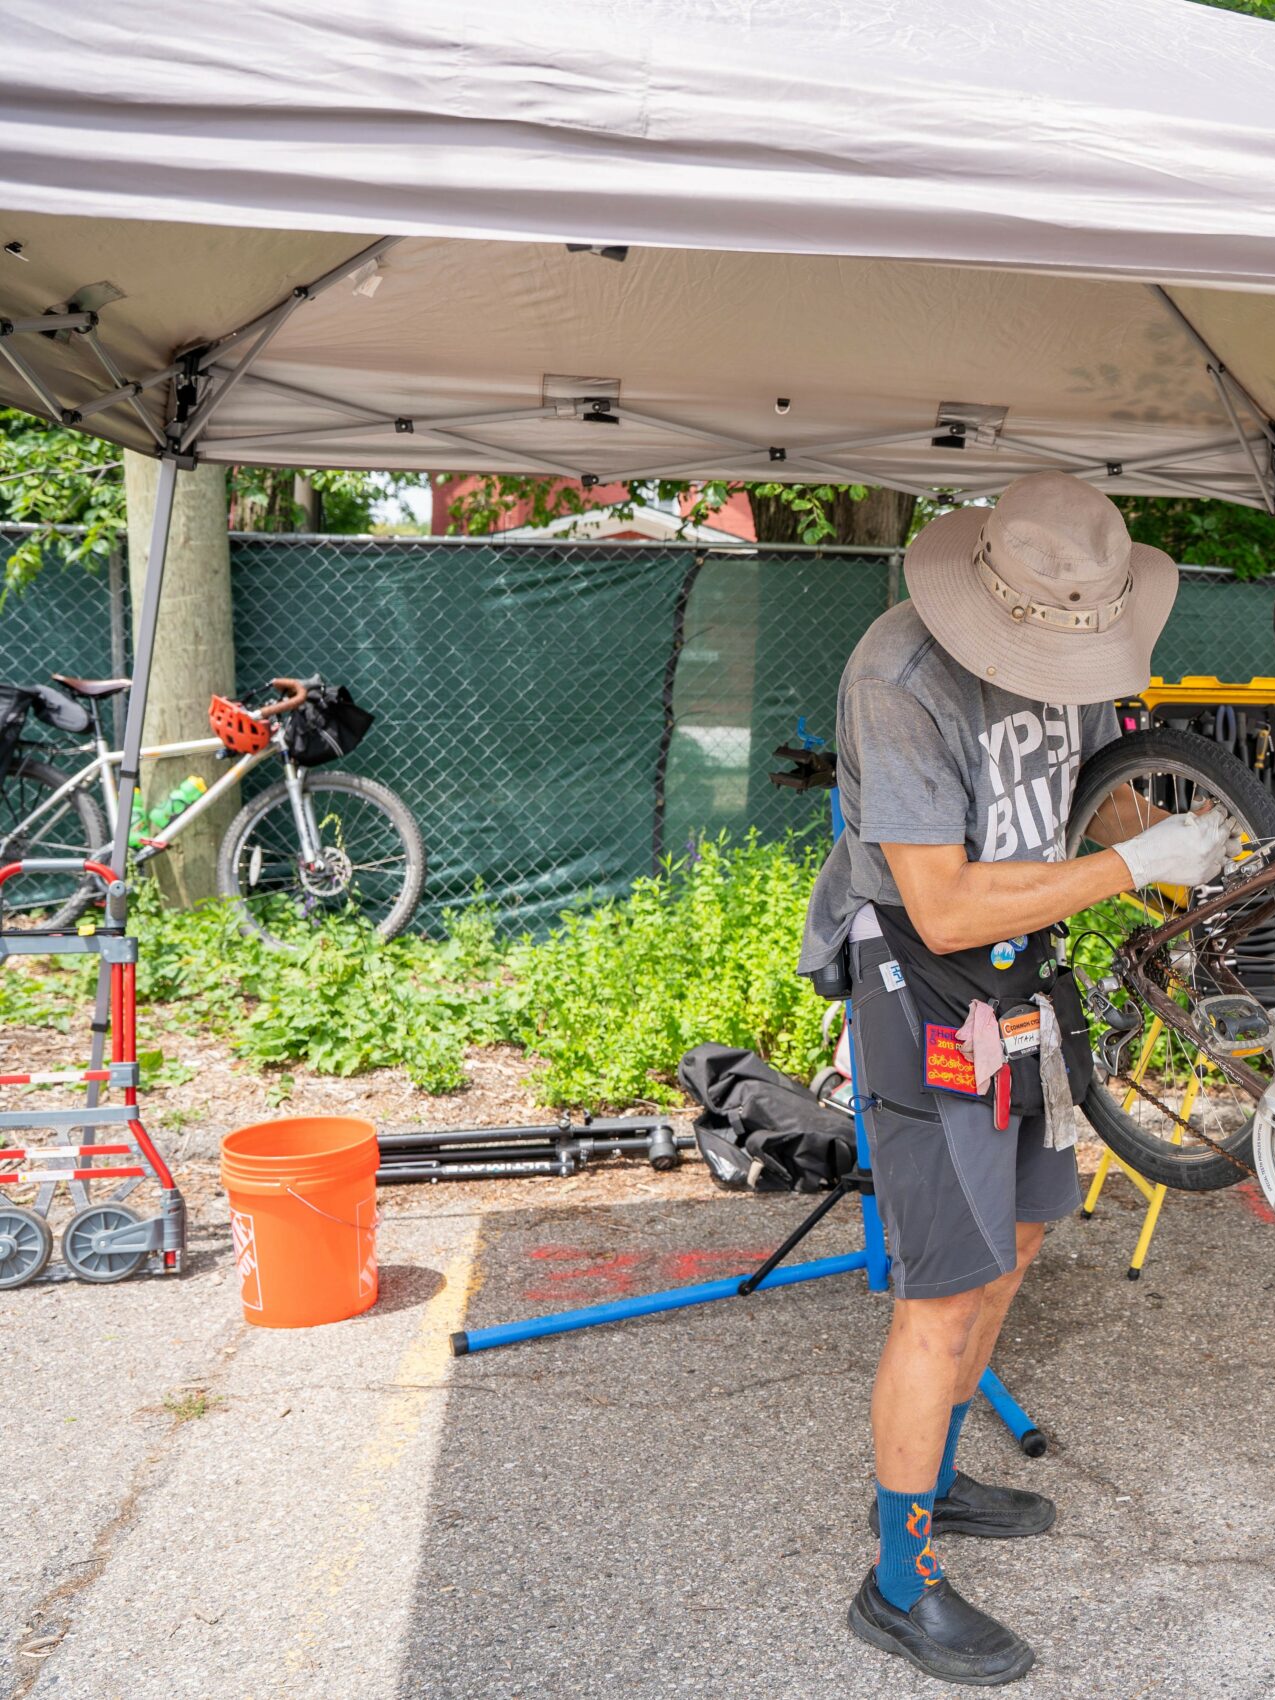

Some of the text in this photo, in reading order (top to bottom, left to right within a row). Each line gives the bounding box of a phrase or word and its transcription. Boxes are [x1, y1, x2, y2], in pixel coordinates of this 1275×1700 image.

[978, 702, 1080, 797] YPSI
[937, 1039, 955, 1050] 2013
[443, 1161, 550, 1175] ULTIMATE
